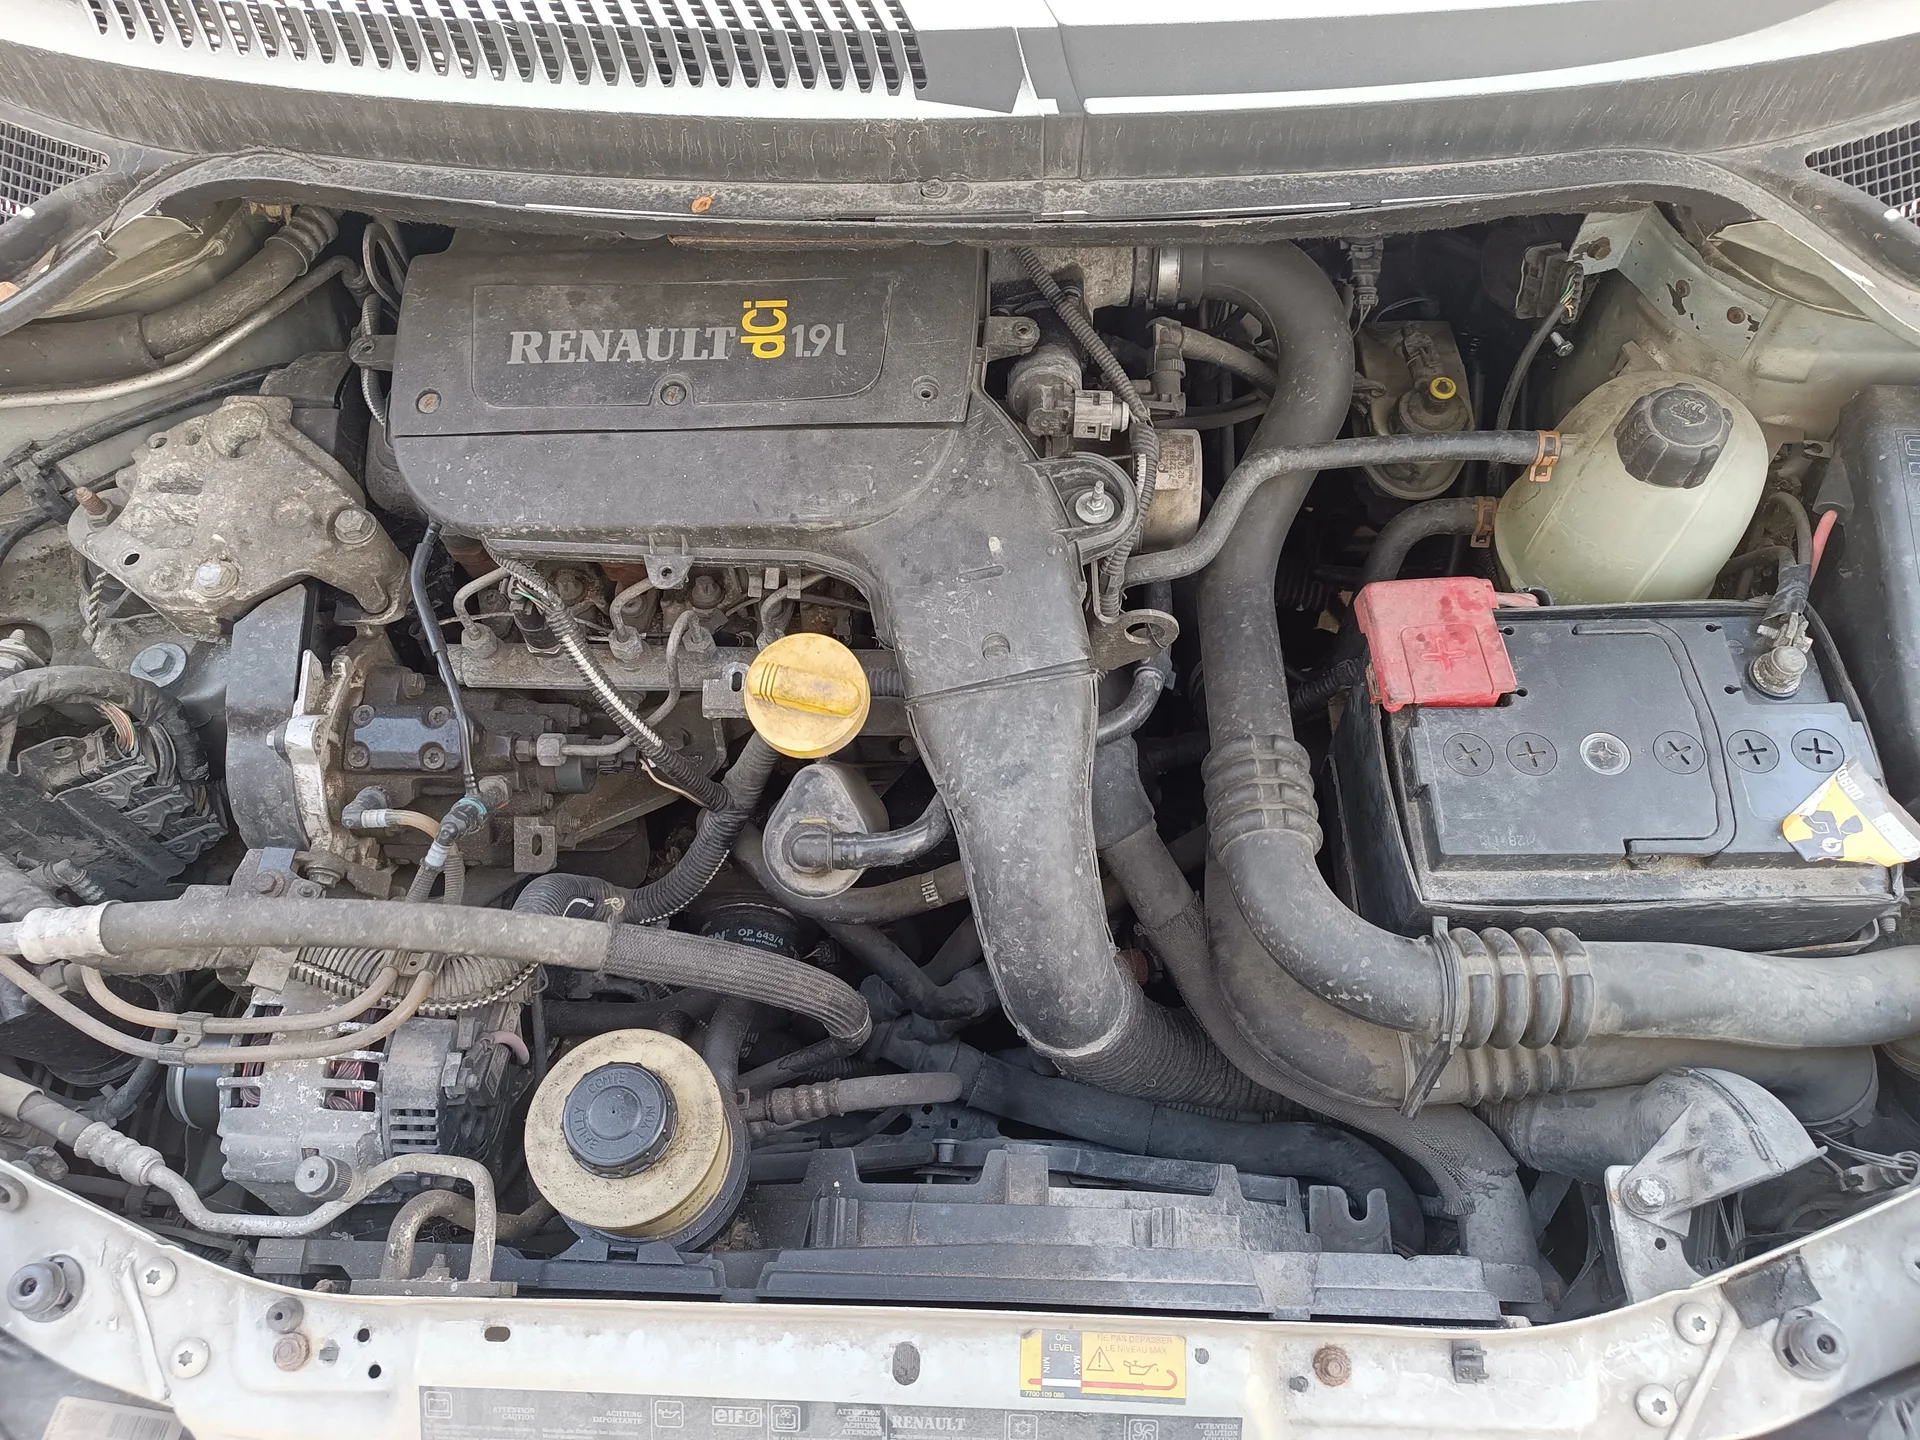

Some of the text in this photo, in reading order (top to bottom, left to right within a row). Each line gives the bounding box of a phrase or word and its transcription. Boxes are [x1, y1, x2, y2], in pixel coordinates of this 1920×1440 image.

[506, 326, 737, 365] RENAULT
[740, 299, 789, 360] dCi
[737, 928, 754, 937] OP
[1054, 1333, 1069, 1342] OIL
[1097, 1333, 1173, 1345] NE PAS DEPASSER
[1049, 1343, 1075, 1352] LEVEL
[1105, 1344, 1168, 1355] LE NIVEAU MAX
[1043, 1356, 1051, 1375] MIN
[1073, 1355, 1081, 1375] MAX
[1025, 1390, 1041, 1398] 7700
[492, 1406, 536, 1414] ATTENTION
[605, 1410, 643, 1418] ACHTUNG
[836, 1408, 882, 1416] ATTENTION
[501, 1413, 536, 1421] CAUTION
[592, 1416, 643, 1425] IMPORTANTE
[714, 1408, 745, 1424] elf
[846, 1415, 881, 1423] CAUTION
[843, 1422, 882, 1430] ACHTUNG
[891, 1415, 966, 1432] RENAULT
[1194, 1422, 1239, 1431] ATTENTION
[1203, 1429, 1239, 1437] CAUTION
